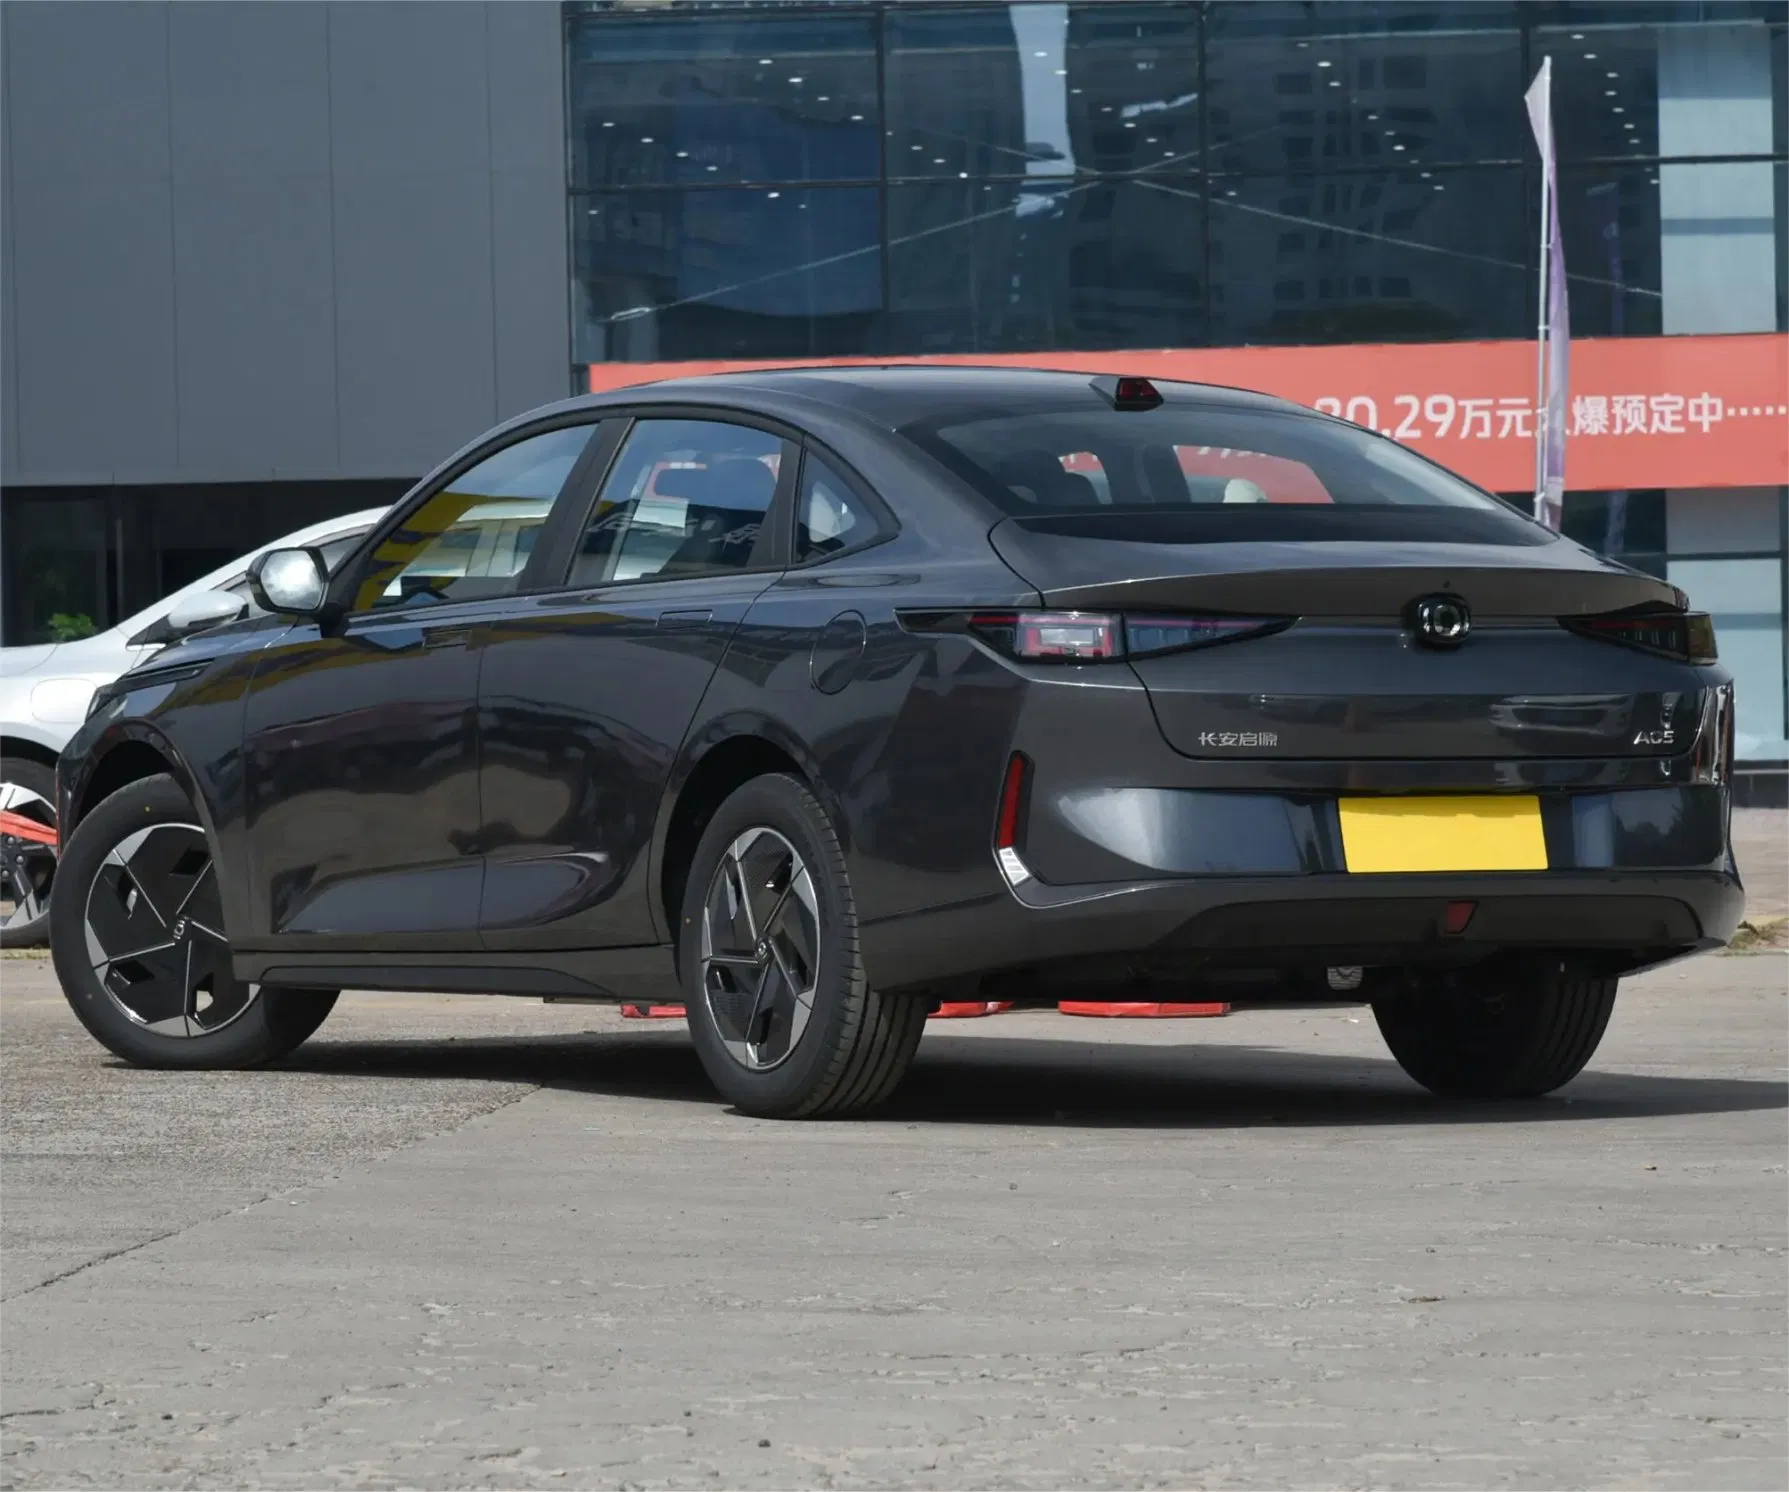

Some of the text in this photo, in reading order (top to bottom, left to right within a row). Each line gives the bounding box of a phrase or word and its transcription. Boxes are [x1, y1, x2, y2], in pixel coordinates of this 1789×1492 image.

[1198, 731, 1278, 747] 长安启源
[1633, 730, 1675, 745] A05
